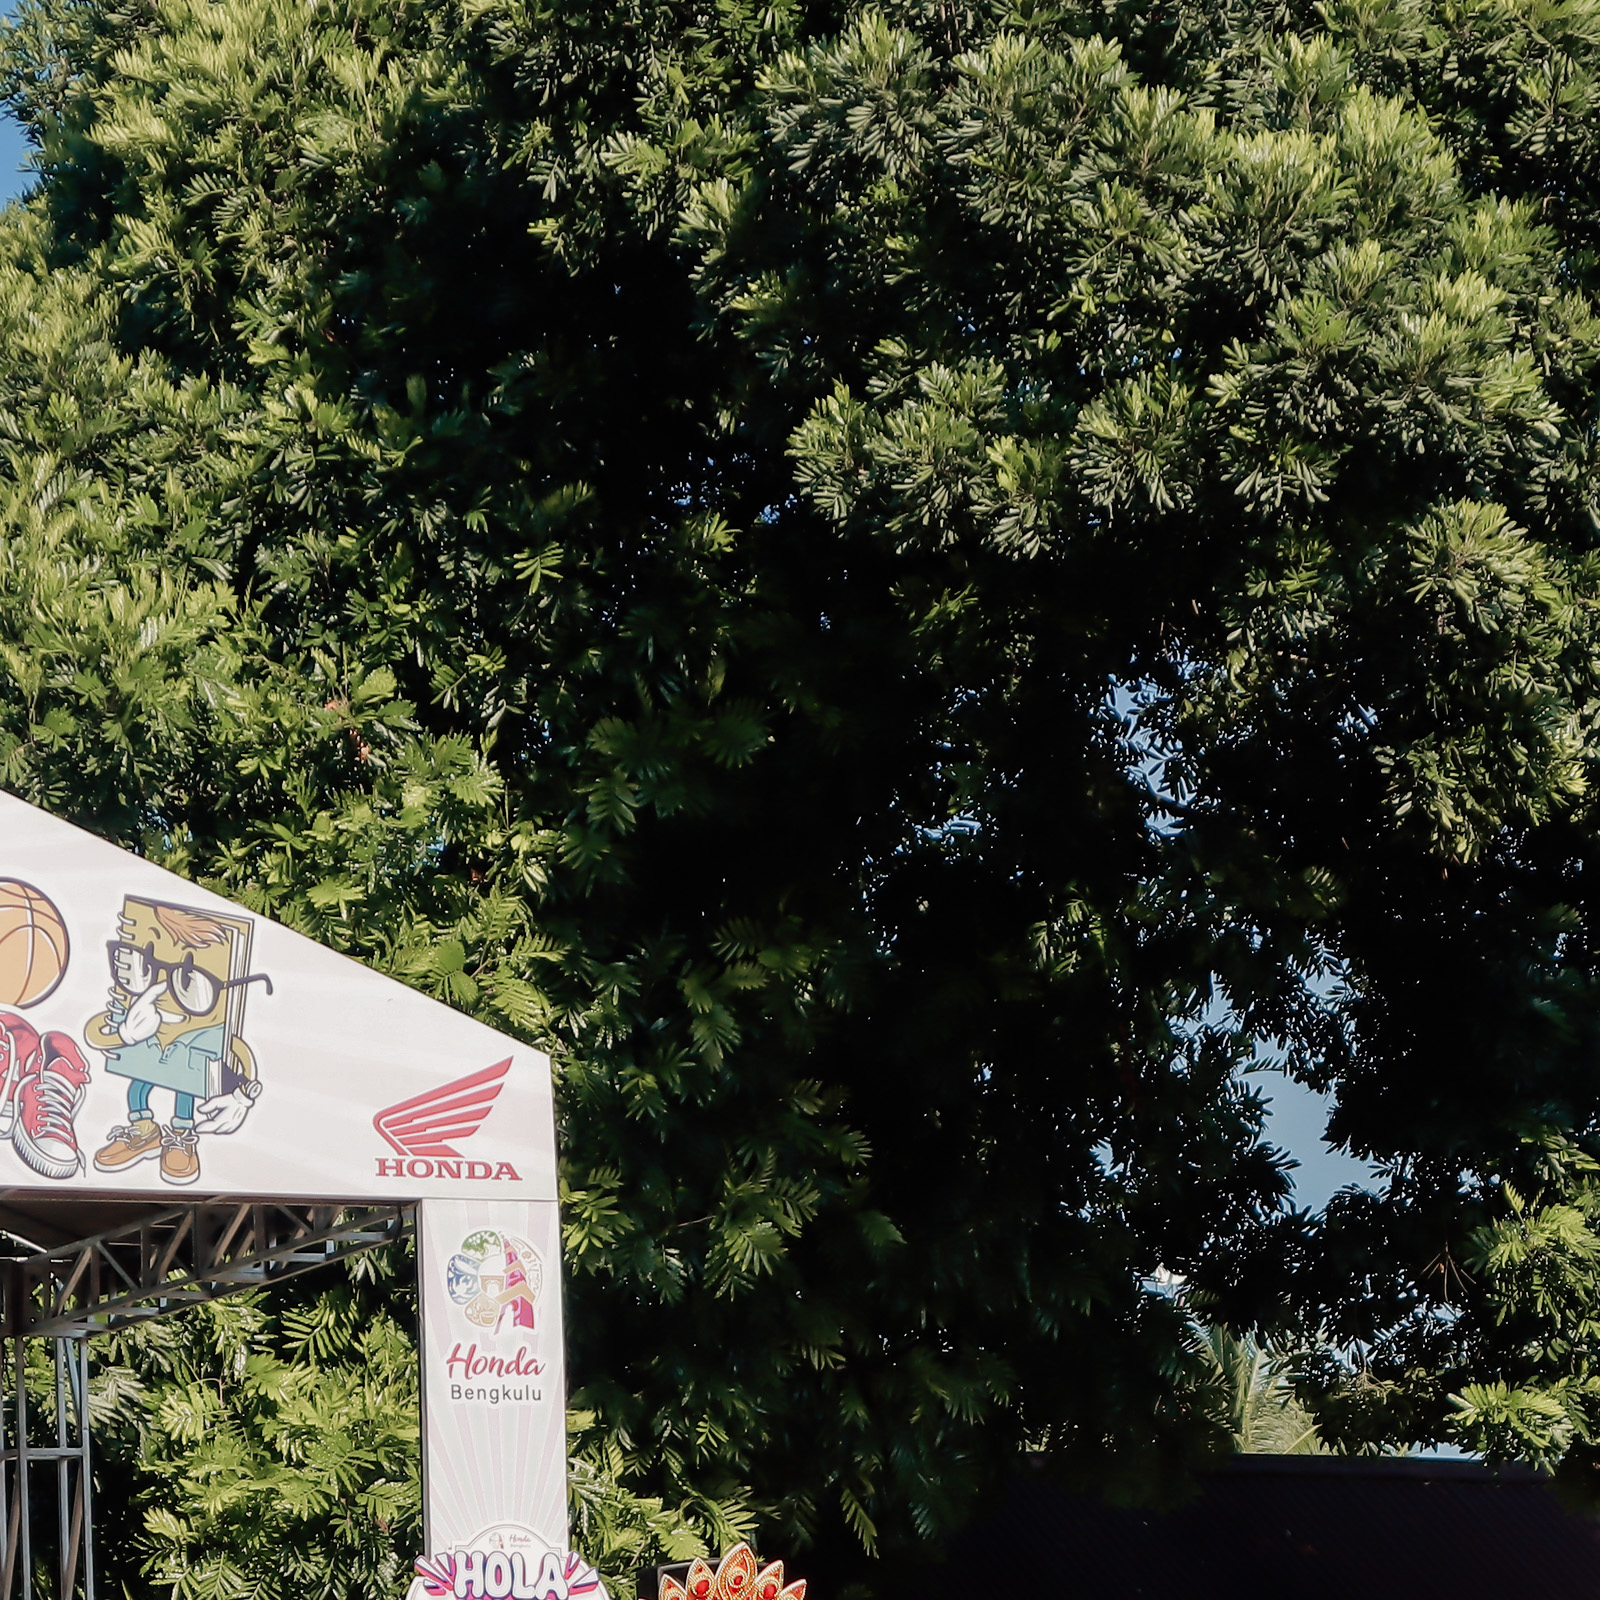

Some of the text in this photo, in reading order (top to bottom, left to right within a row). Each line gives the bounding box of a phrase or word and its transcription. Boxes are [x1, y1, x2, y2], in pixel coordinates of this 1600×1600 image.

[375, 1158, 523, 1181] HONDA
[446, 1343, 546, 1380] Honda
[451, 1384, 541, 1404] Bengkulu
[453, 1551, 568, 1600] HOLA
